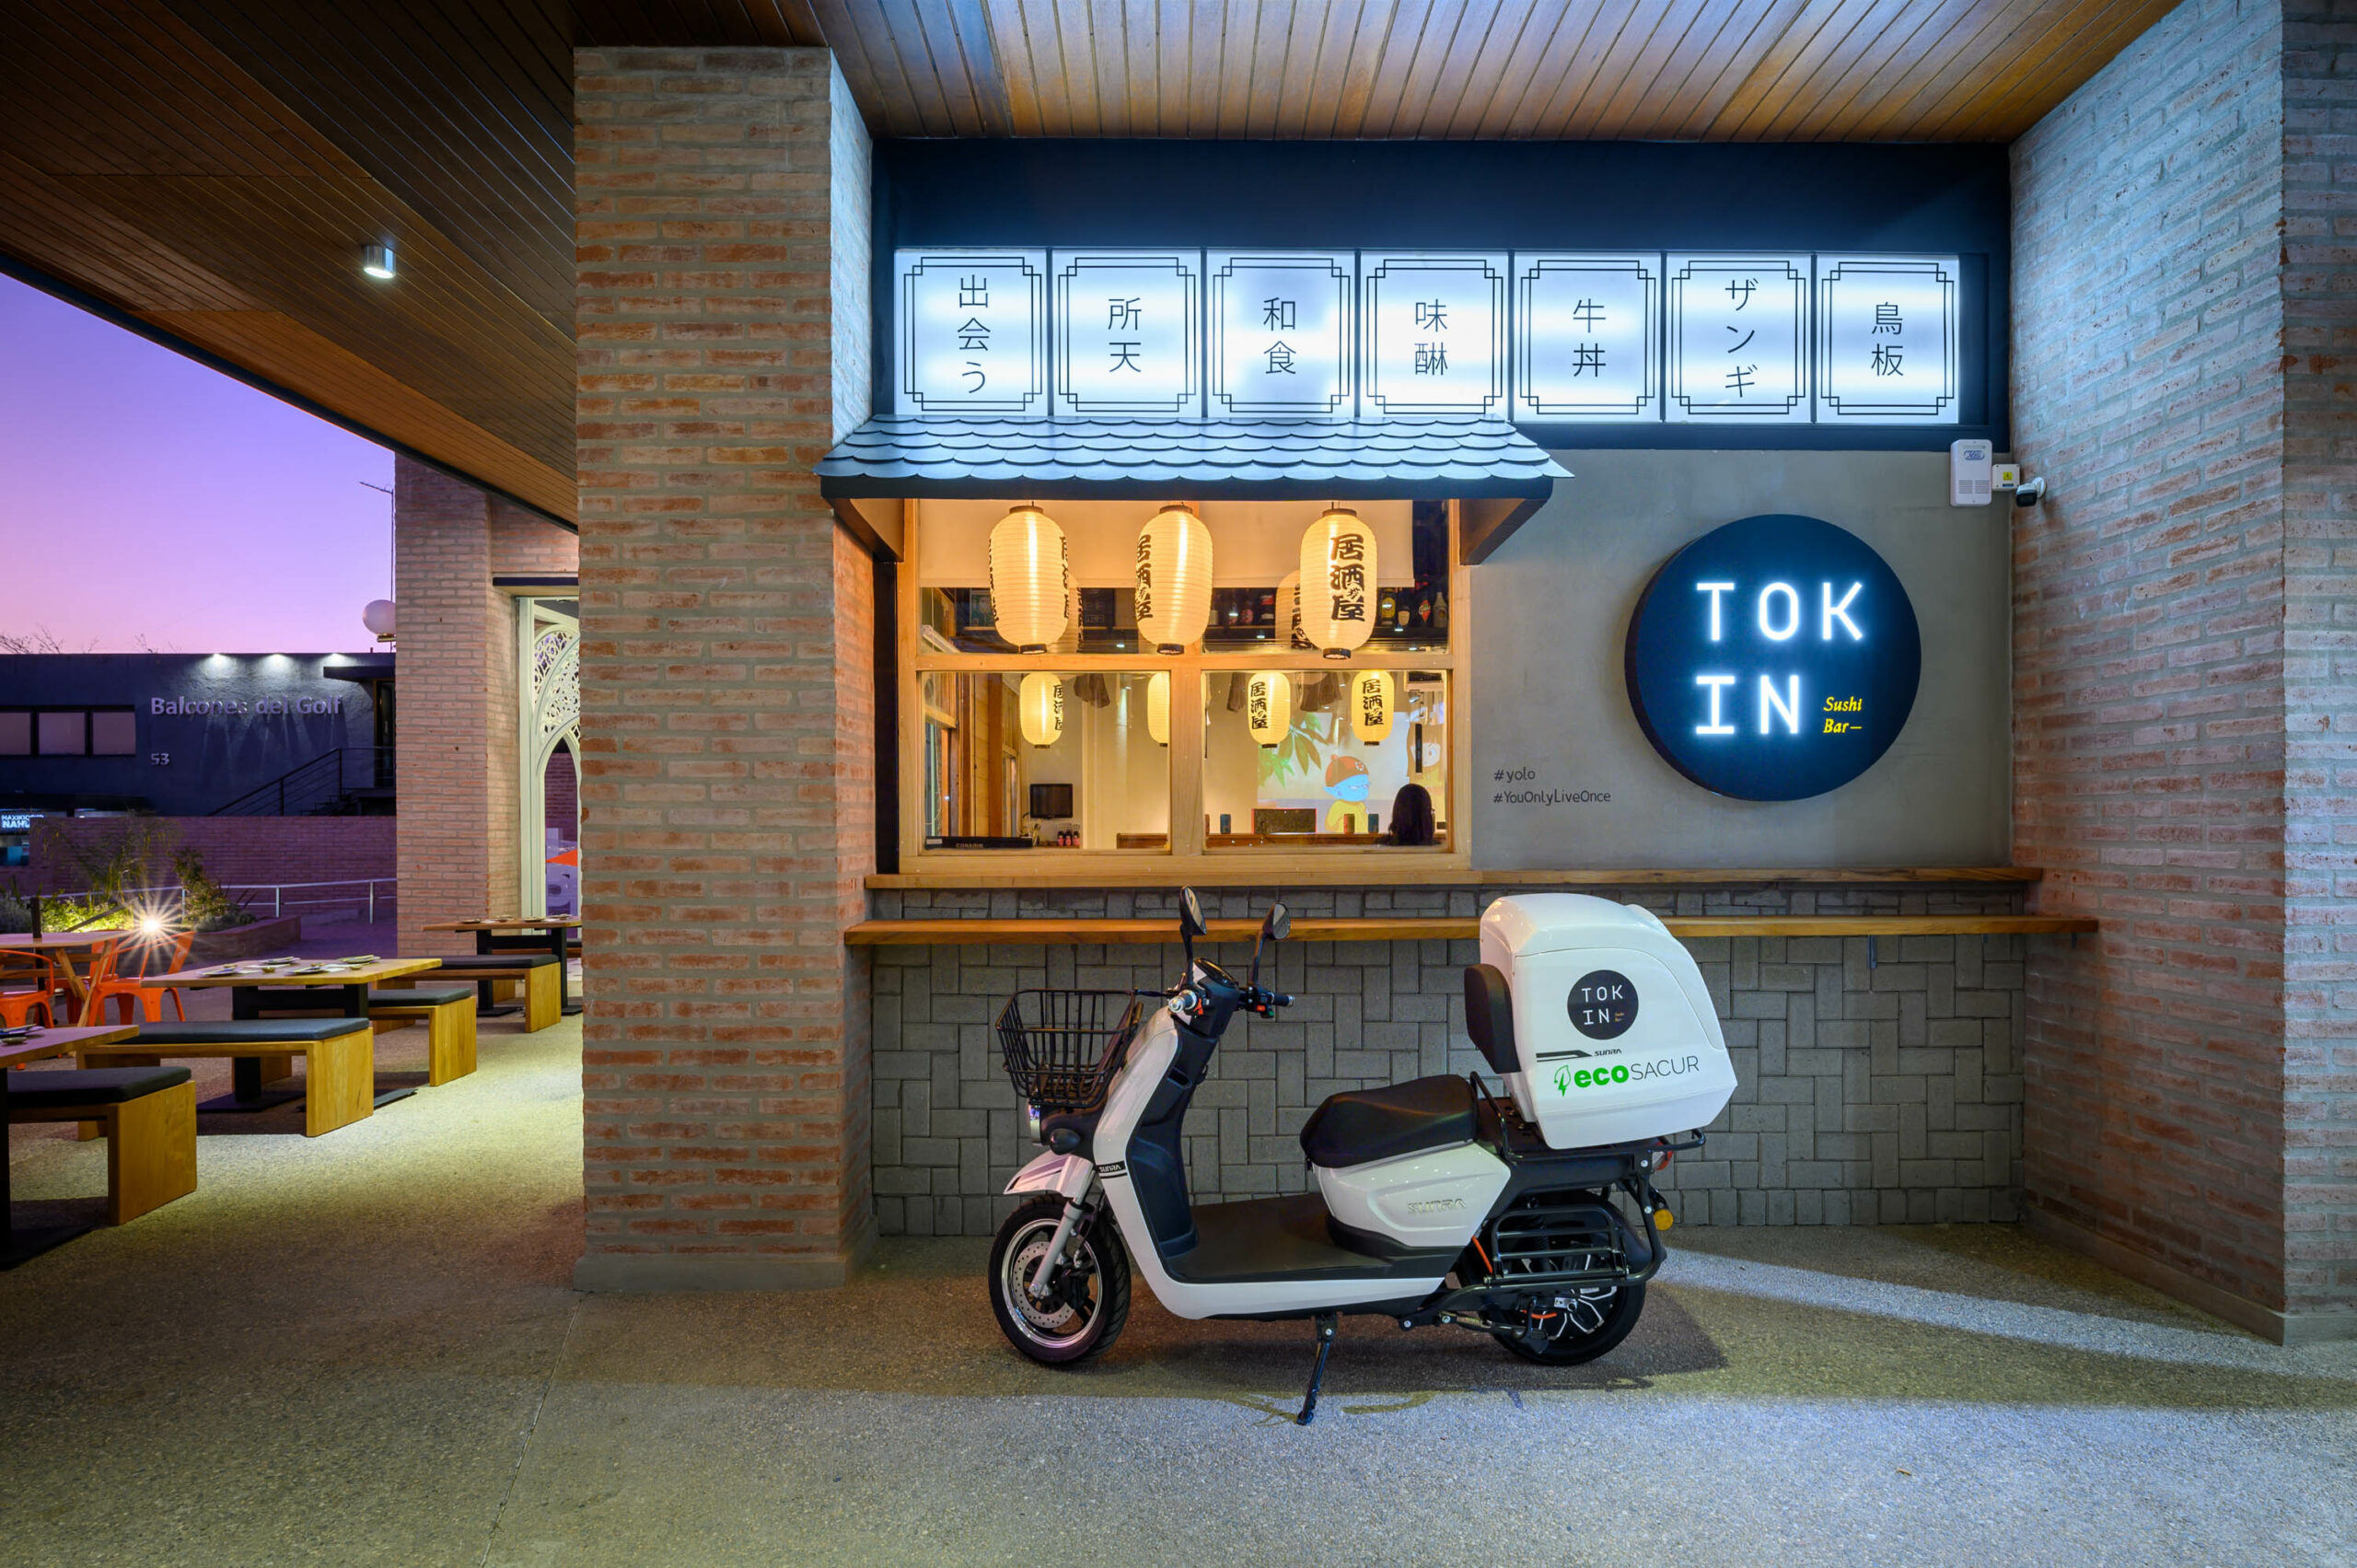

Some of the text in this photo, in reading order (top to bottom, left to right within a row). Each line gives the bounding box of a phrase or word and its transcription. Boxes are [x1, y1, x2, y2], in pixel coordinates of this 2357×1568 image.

[957, 273, 991, 393] 出会う
[1108, 297, 1142, 372] 所天
[1263, 296, 1296, 375] 和食
[1415, 298, 1448, 376] 味醂
[1572, 298, 1607, 377] 牛丼
[1724, 277, 1759, 398] ザンギ
[1871, 301, 1904, 377] 鳥板
[1329, 532, 1365, 622] 居酒屋
[1696, 581, 1864, 643] TOK
[150, 695, 343, 715] Balcones del Golf
[1250, 680, 1269, 730] 居酒屋
[1362, 678, 1384, 726] 居酒屋
[1695, 674, 1801, 736] IN
[1823, 695, 1864, 713] Sushi
[150, 752, 170, 766] 53
[1493, 766, 1536, 784] #yolo
[1492, 788, 1611, 807] #YouOnlyLiveOnce
[1581, 984, 1623, 1003] TOK
[1583, 1008, 1609, 1026] IN
